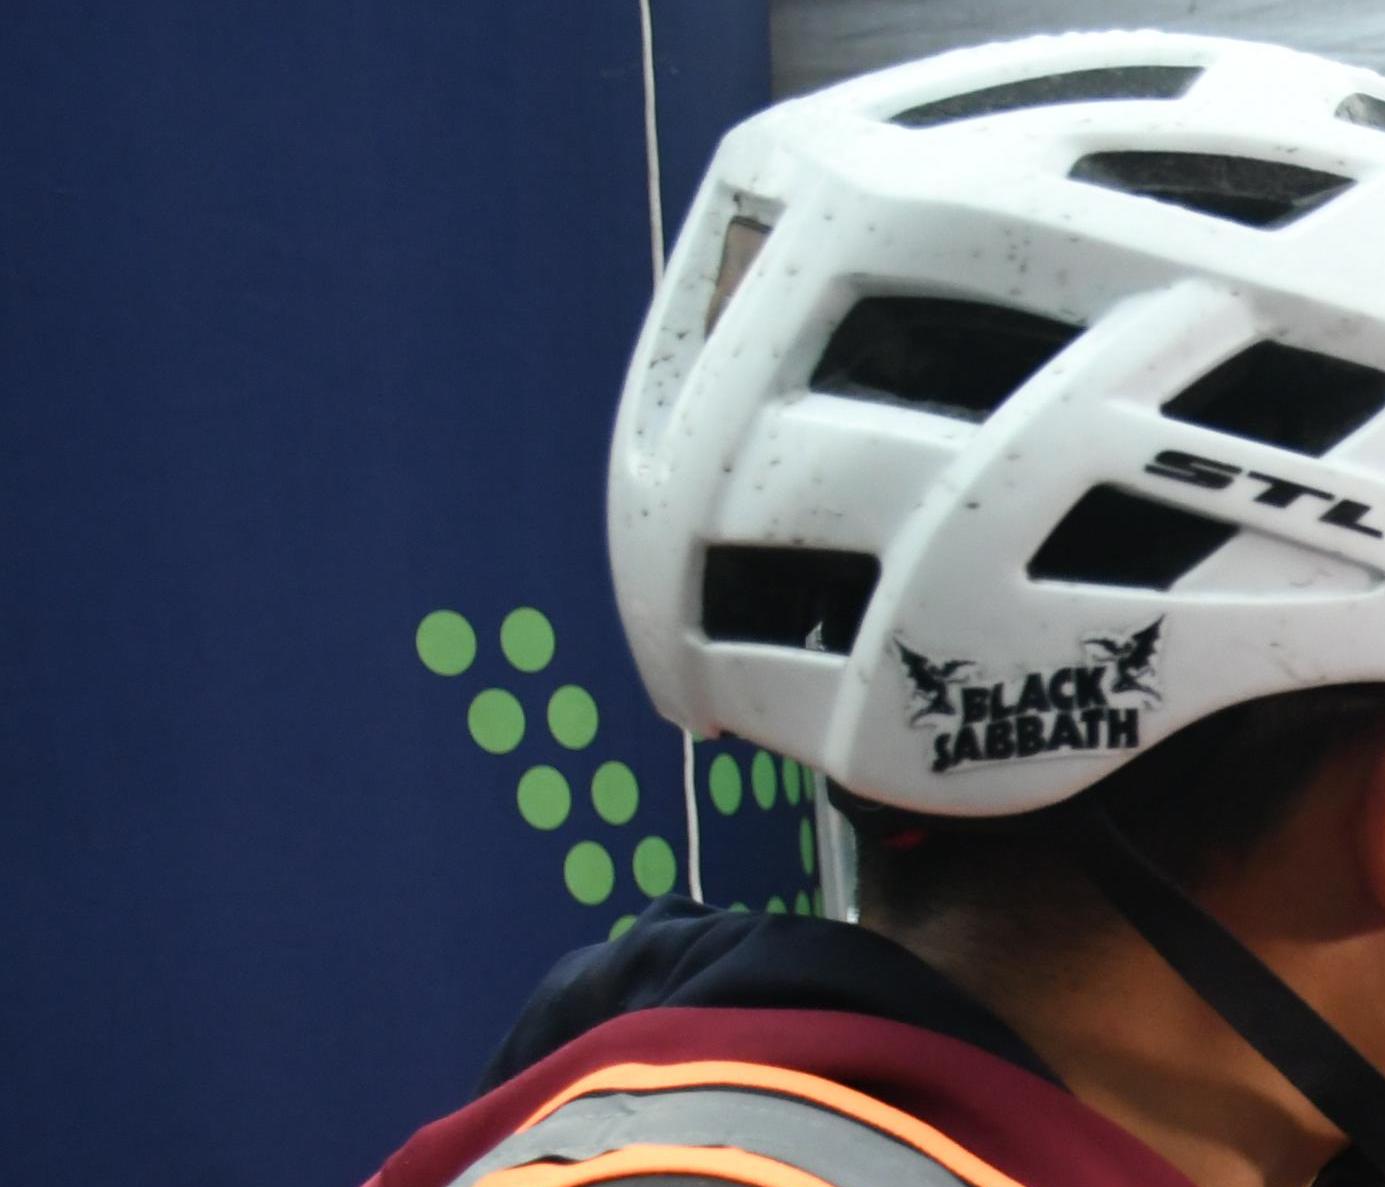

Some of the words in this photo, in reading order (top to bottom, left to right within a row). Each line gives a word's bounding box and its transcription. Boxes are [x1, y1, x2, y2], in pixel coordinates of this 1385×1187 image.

[1144, 449, 1384, 539] STL
[961, 666, 1108, 724] BLACK
[931, 708, 1140, 774] SABBATH
